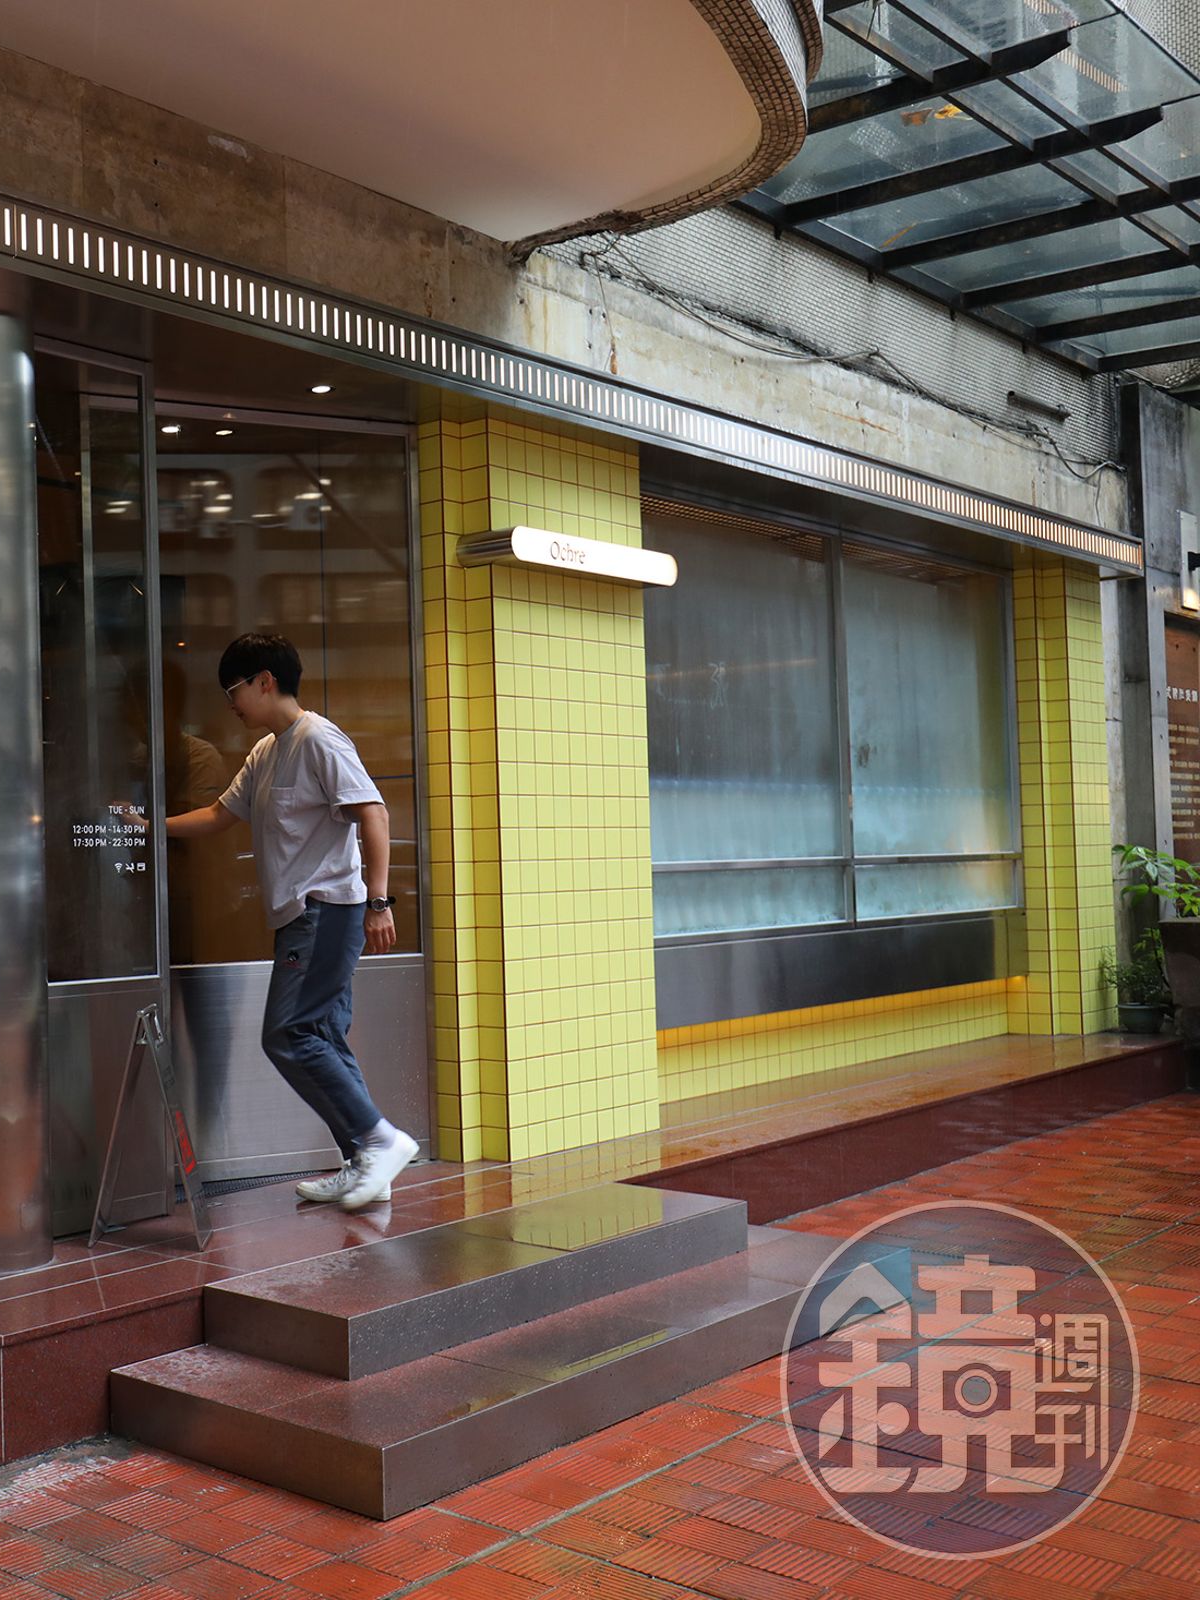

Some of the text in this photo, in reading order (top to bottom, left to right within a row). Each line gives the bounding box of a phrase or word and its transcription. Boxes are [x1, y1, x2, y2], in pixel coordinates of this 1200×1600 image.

[550, 541, 586, 564] Ochre
[108, 805, 123, 814] TUE
[129, 805, 145, 814] SUN
[72, 825, 93, 834] 12:00
[94, 825, 107, 834] PM
[112, 825, 133, 834] 14:30
[133, 825, 146, 834] PM
[73, 838, 94, 847] 17:30
[94, 838, 107, 847] PM
[112, 838, 133, 847] 22:30
[133, 838, 146, 847] PM
